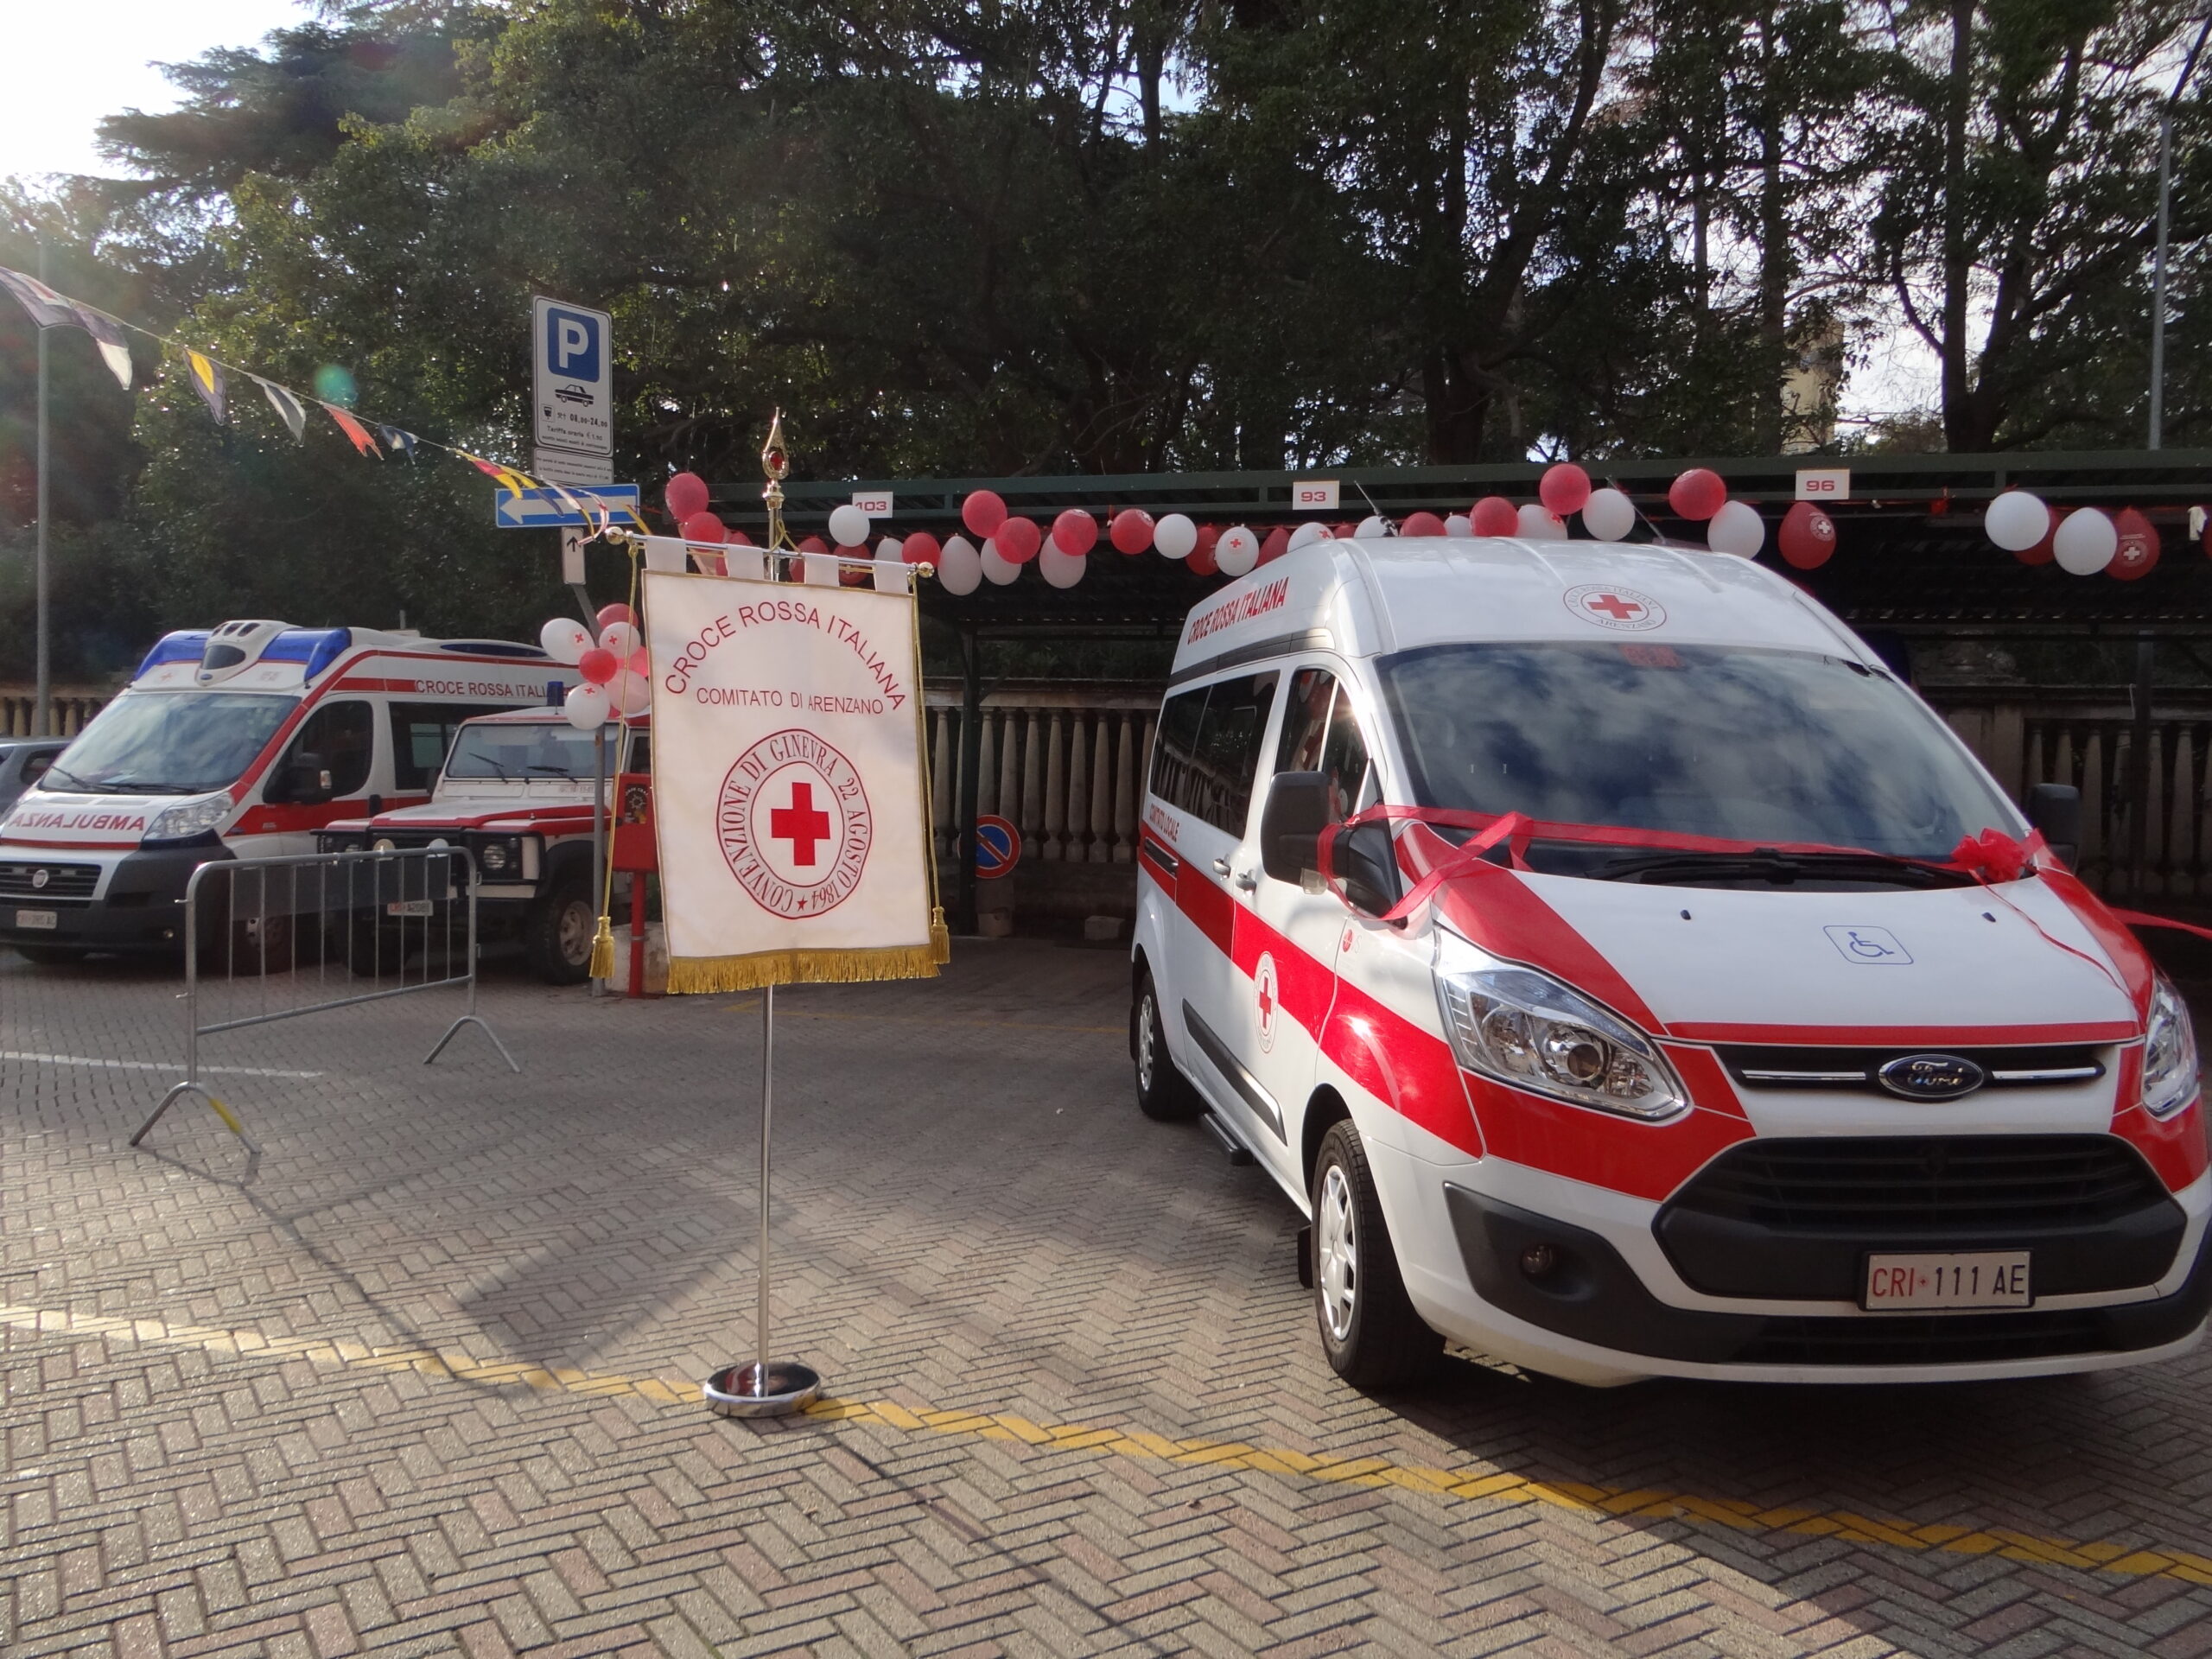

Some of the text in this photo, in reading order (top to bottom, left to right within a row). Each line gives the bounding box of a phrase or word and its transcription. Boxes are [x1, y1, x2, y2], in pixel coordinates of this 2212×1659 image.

[558, 317, 589, 369] P
[1300, 491, 1326, 502] 93
[1806, 480, 1835, 492] 96
[855, 501, 887, 512] 103
[1209, 598, 1240, 635] ROSSA
[1237, 576, 1289, 623] ITALIANA
[665, 601, 906, 710] CROCE ROSSA ITALIANA
[415, 679, 548, 698] CROCE ROSSA ITALI
[696, 687, 884, 715] COMITATO DI ARENZANO
[721, 734, 868, 912] CONVENZIONE DI GINEVRA 22 AGOSTO 1864
[1906, 1060, 1964, 1086] Ford
[1872, 1264, 2026, 1297] CRI 111 AE
